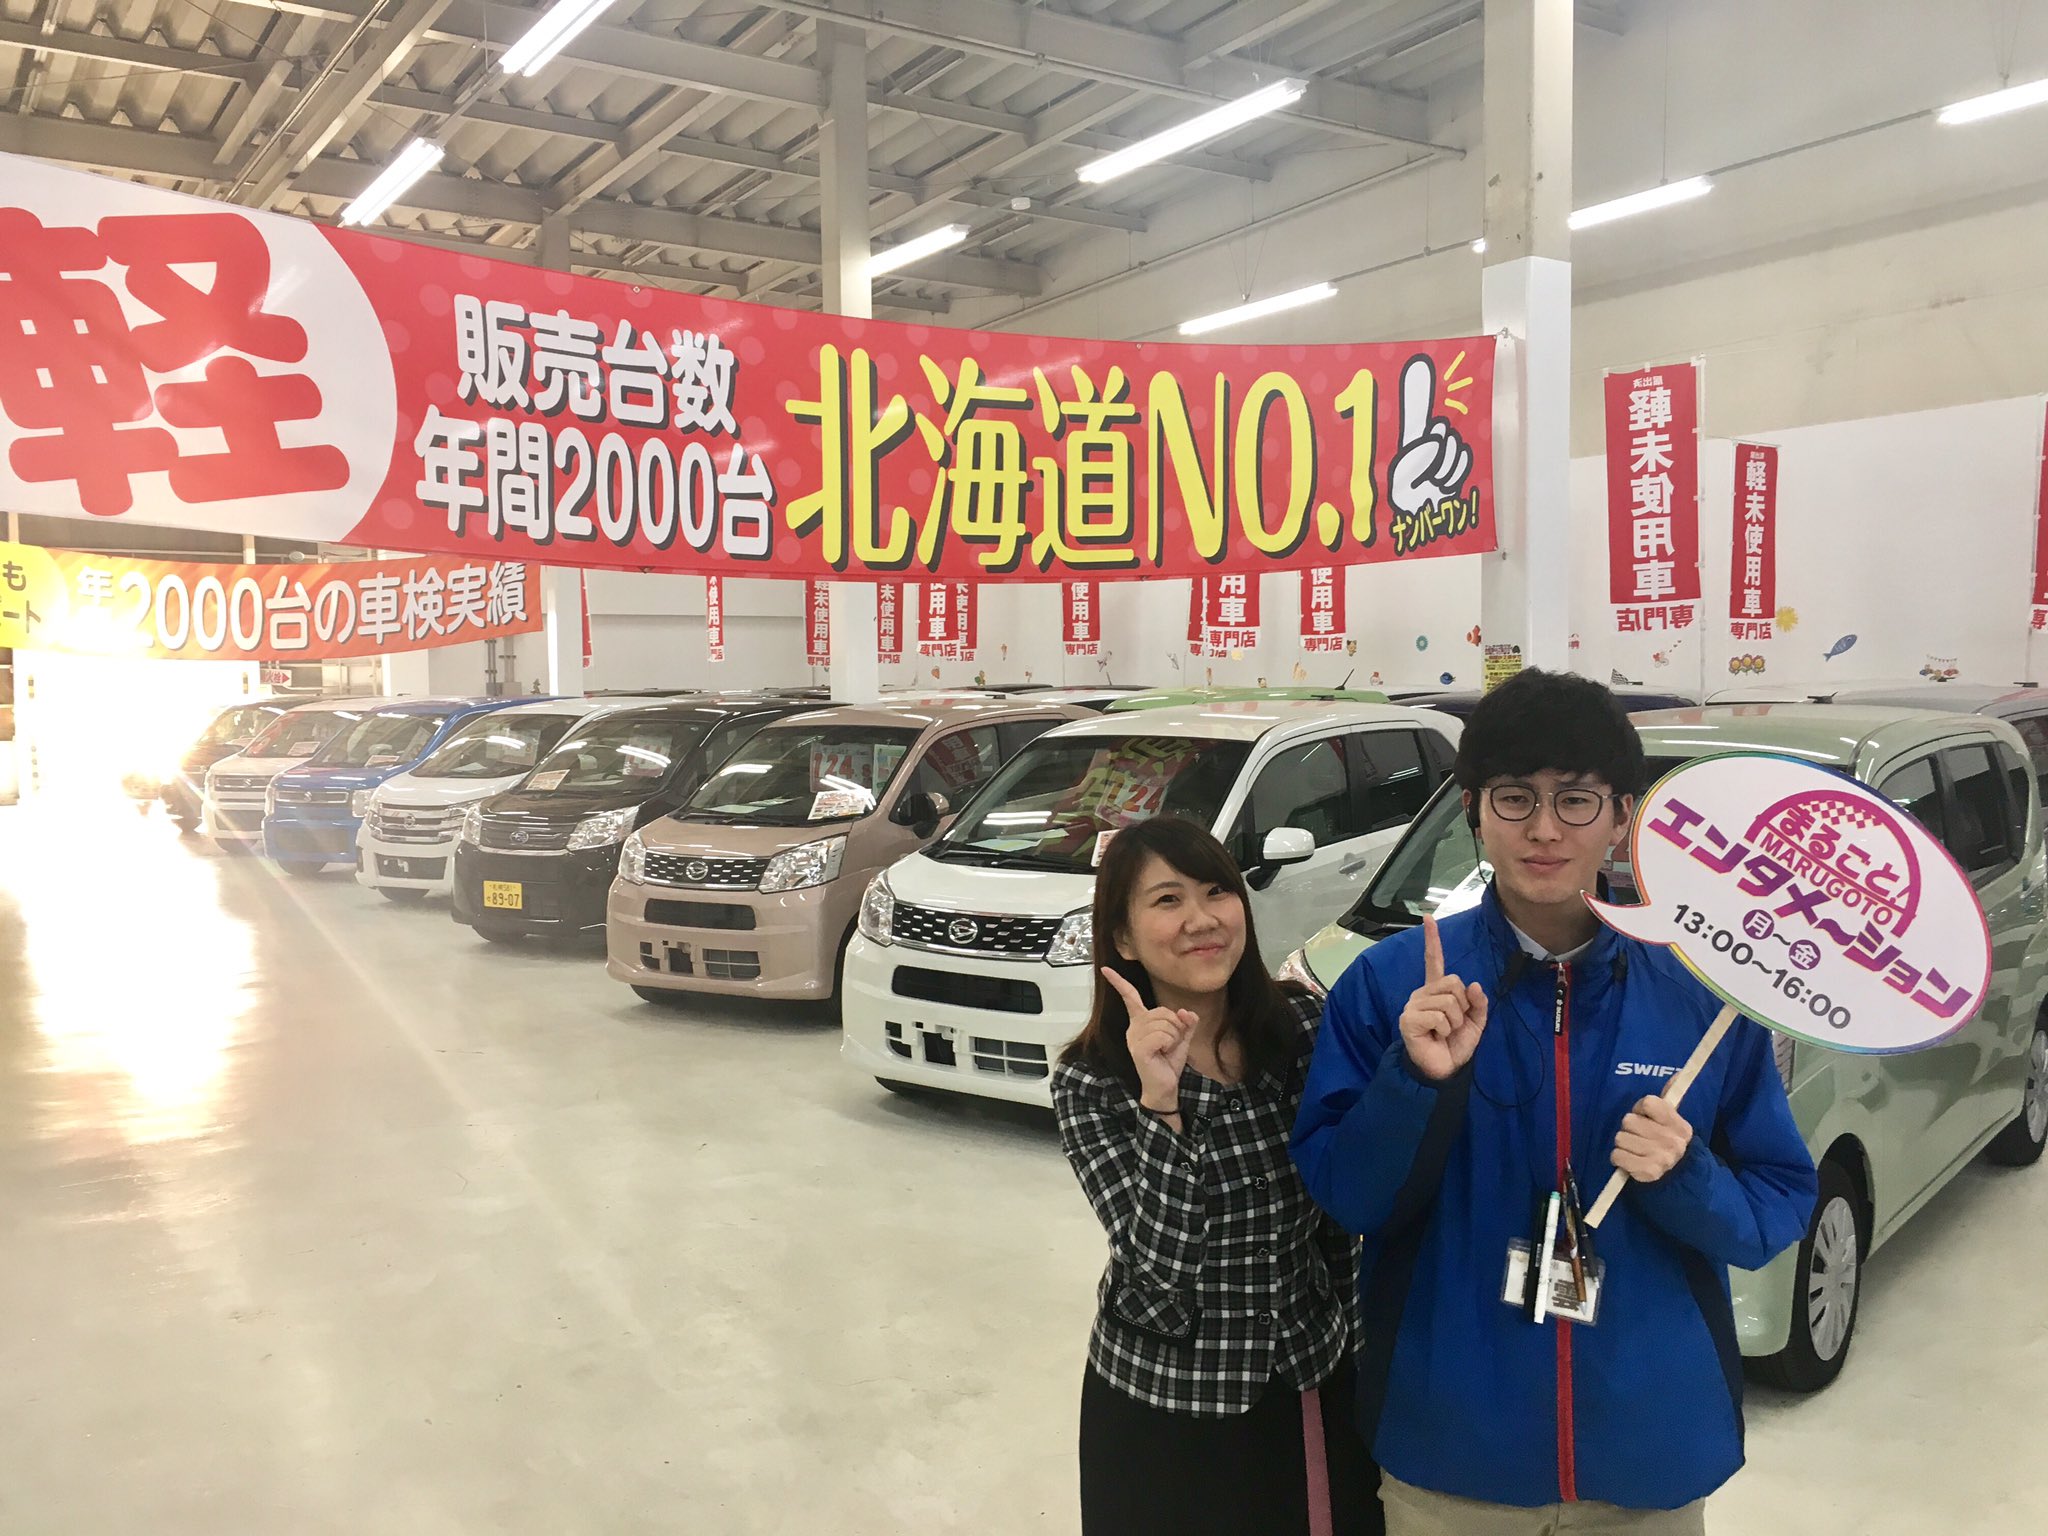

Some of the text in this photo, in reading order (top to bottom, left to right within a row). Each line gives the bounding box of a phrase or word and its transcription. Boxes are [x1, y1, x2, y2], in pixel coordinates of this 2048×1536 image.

[0, 207, 350, 516] 軽
[454, 294, 738, 434] 販売台数
[414, 404, 773, 556] 年間2000台
[786, 343, 1374, 567] 北海道NO.1
[1741, 459, 1767, 618] 軽未使用車
[920, 643, 957, 657] 専門店
[1065, 643, 1098, 655] 専門店
[1071, 582, 1090, 641] 使用車
[1209, 630, 1256, 648] 専門店
[1304, 637, 1343, 651] 専門店
[1730, 621, 1772, 640] 専門店
[1764, 834, 1893, 926] MARUGOTO
[1778, 806, 1901, 896] まるごと
[1673, 905, 1851, 1029] 13:00～16:00
